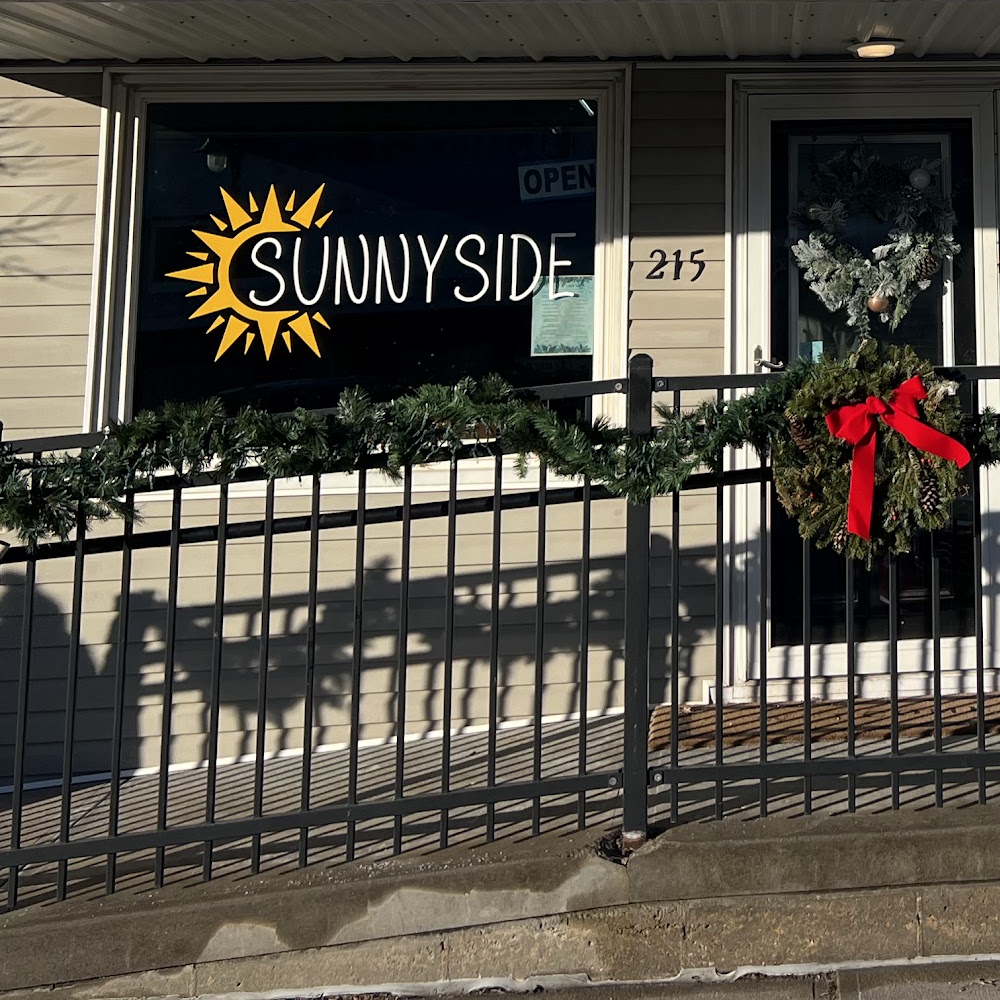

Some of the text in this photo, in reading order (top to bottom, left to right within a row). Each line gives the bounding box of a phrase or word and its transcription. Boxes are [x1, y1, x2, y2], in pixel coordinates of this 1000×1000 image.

[523, 163, 597, 195] OPEN
[248, 233, 576, 307] SUNNYSIDE
[645, 249, 706, 282] 215
